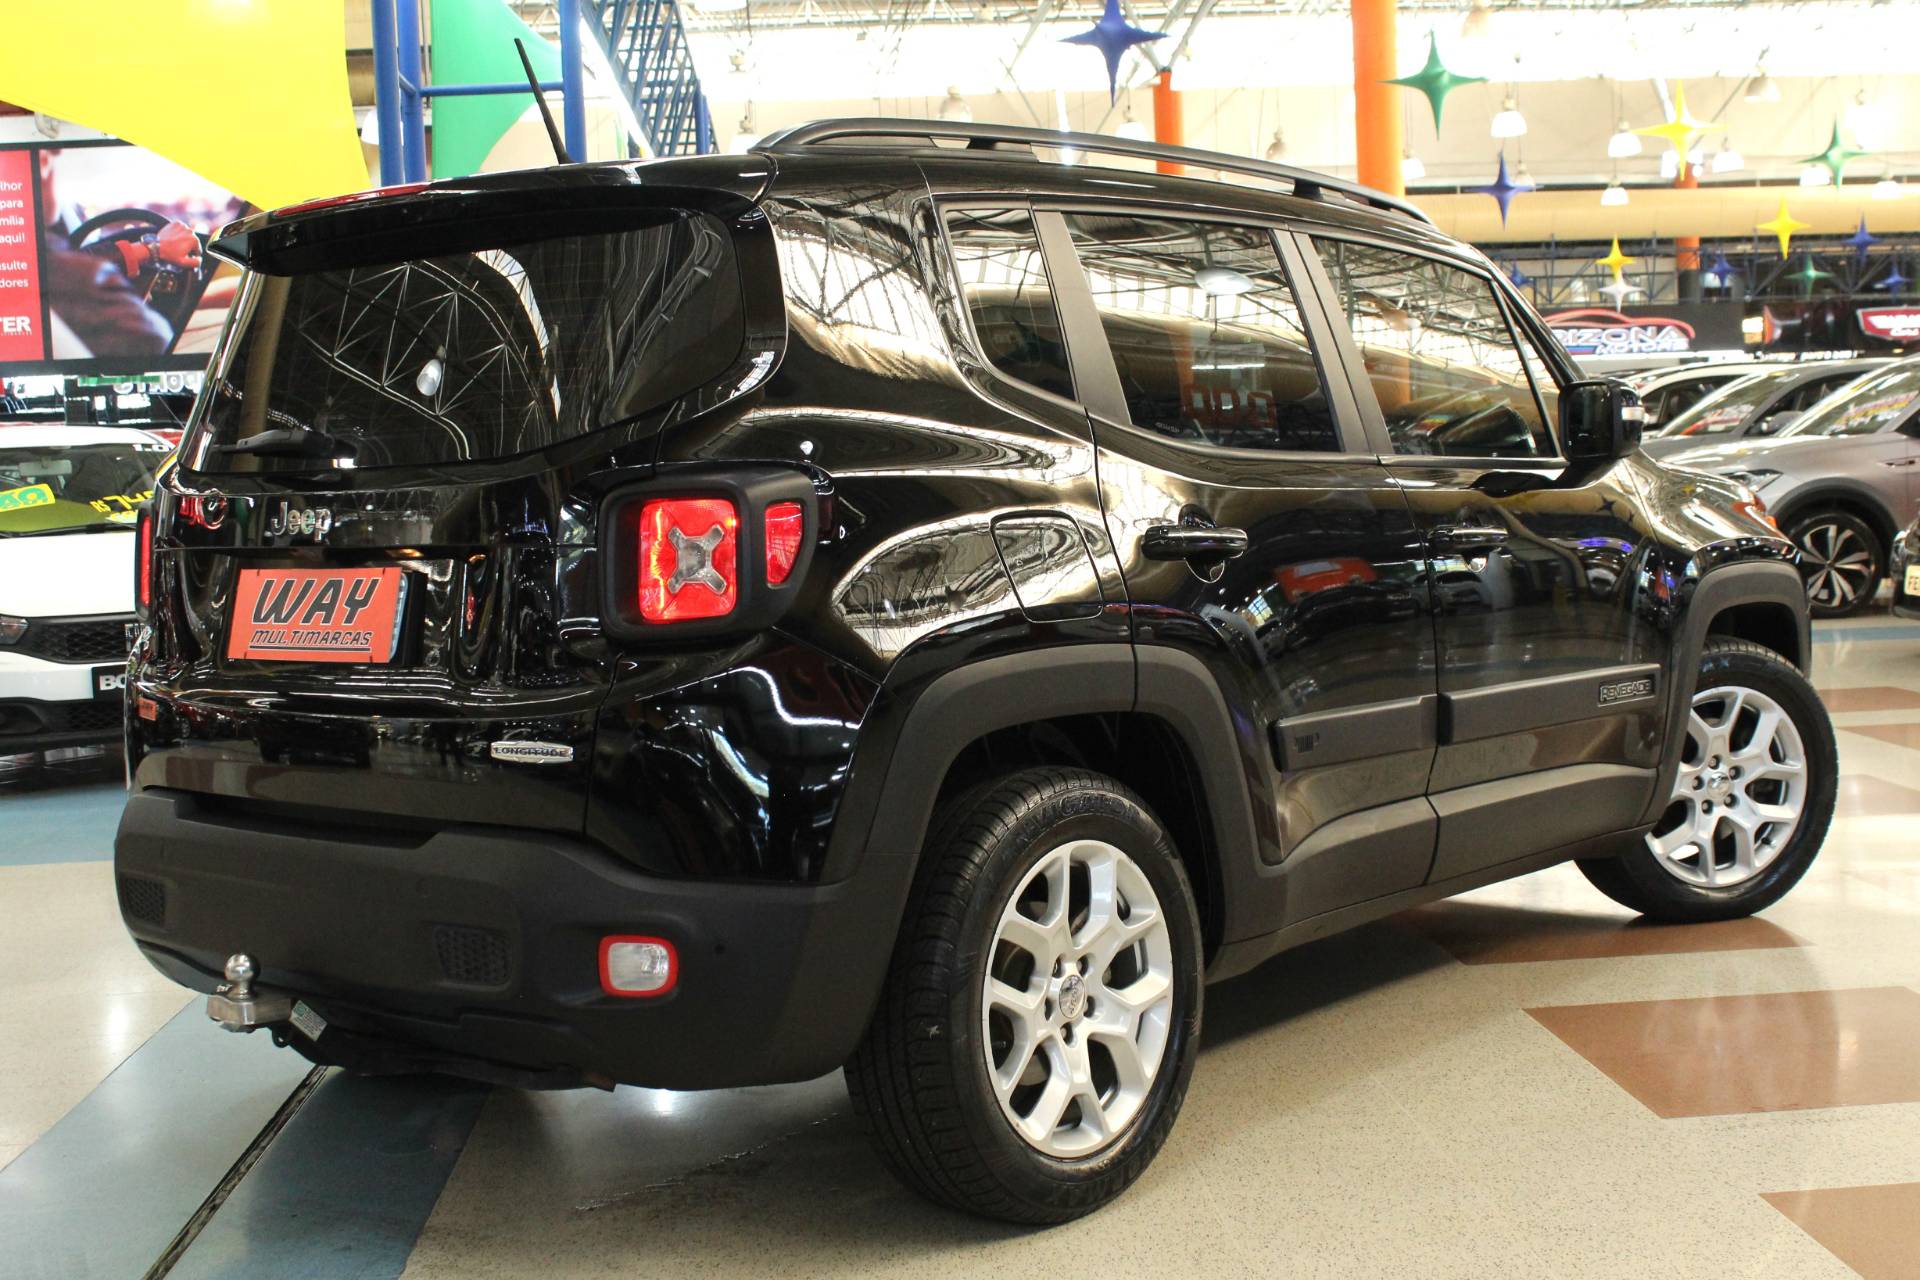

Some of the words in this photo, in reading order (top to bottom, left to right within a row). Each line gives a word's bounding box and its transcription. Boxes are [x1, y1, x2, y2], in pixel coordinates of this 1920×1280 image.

[0, 259, 28, 271] sulte
[0, 315, 32, 332] ER
[271, 501, 332, 541] Jeep
[252, 577, 382, 626] WAY
[249, 628, 374, 646] MULTIMARCAS
[1600, 680, 1651, 701] RENEGADE
[494, 746, 569, 757] LONGITUDE
